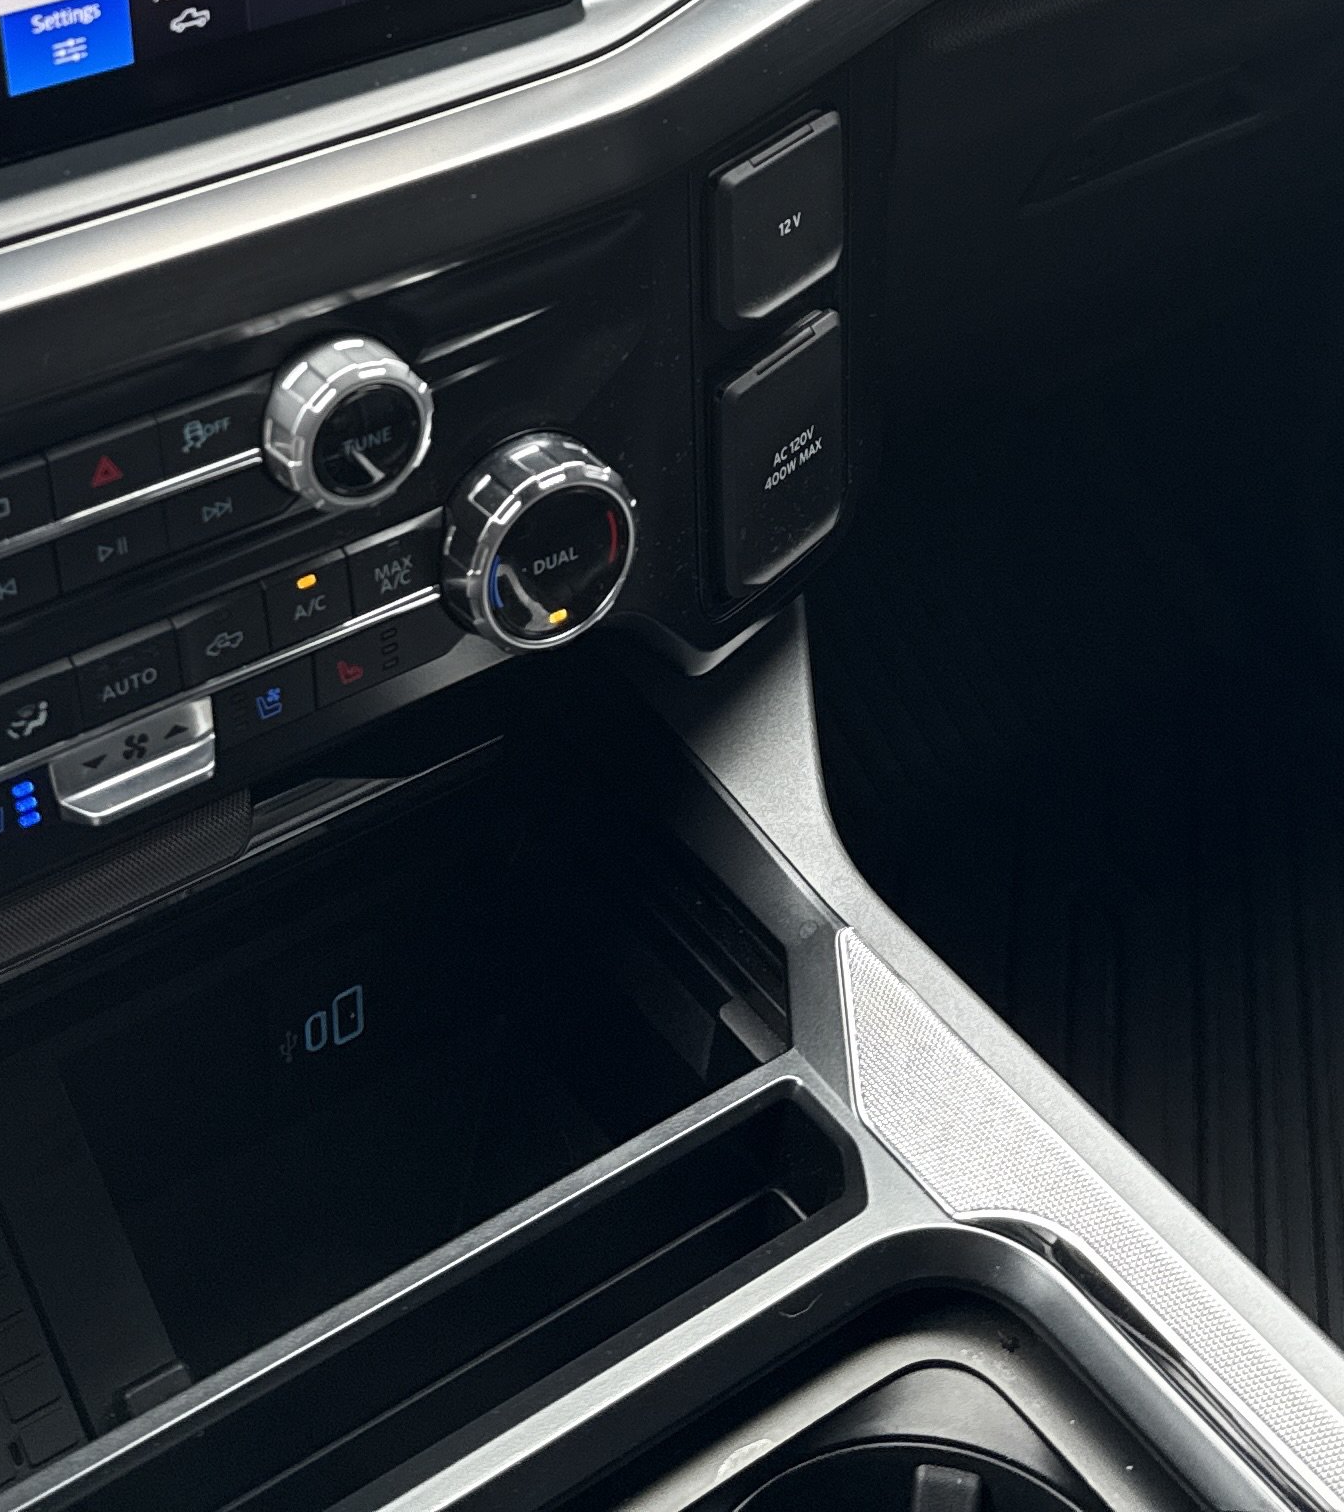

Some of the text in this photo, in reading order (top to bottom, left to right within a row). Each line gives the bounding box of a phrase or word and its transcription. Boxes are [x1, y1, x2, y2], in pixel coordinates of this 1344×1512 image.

[30, 3, 102, 35] Settings
[206, 417, 231, 437] OFF
[343, 426, 393, 455] TUNE
[773, 425, 815, 467] AC 120V
[764, 437, 823, 491] 400W MAX
[375, 555, 414, 582] MAX
[533, 547, 579, 575] DUAL
[380, 570, 412, 594] A/C
[294, 595, 327, 621] A/C
[101, 668, 158, 702] AUTO
